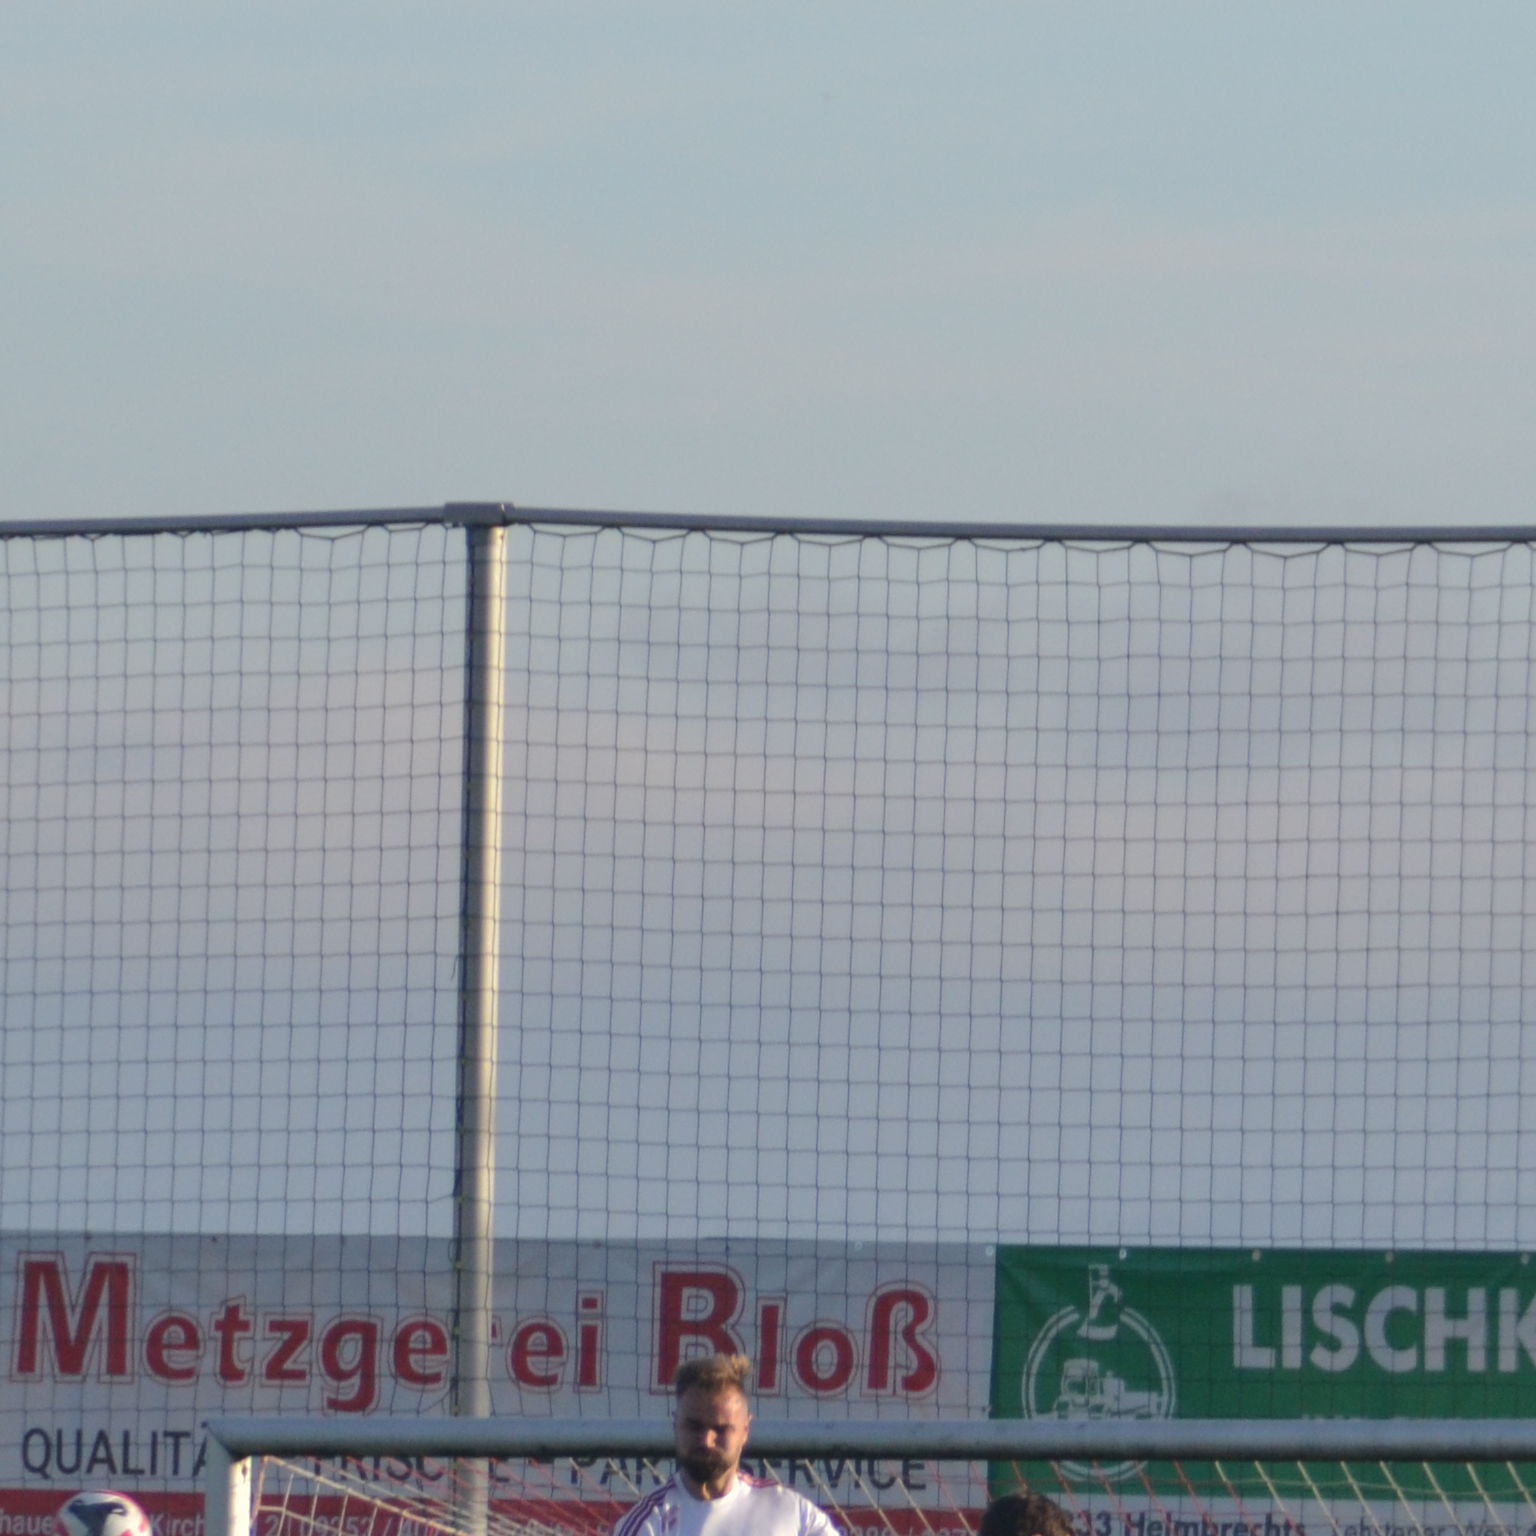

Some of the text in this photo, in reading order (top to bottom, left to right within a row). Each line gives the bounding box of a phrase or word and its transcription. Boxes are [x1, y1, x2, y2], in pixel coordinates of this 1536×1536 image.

[9, 1251, 941, 1414] Metzgeei Bloß
[21, 1421, 208, 1479] QUALIT
